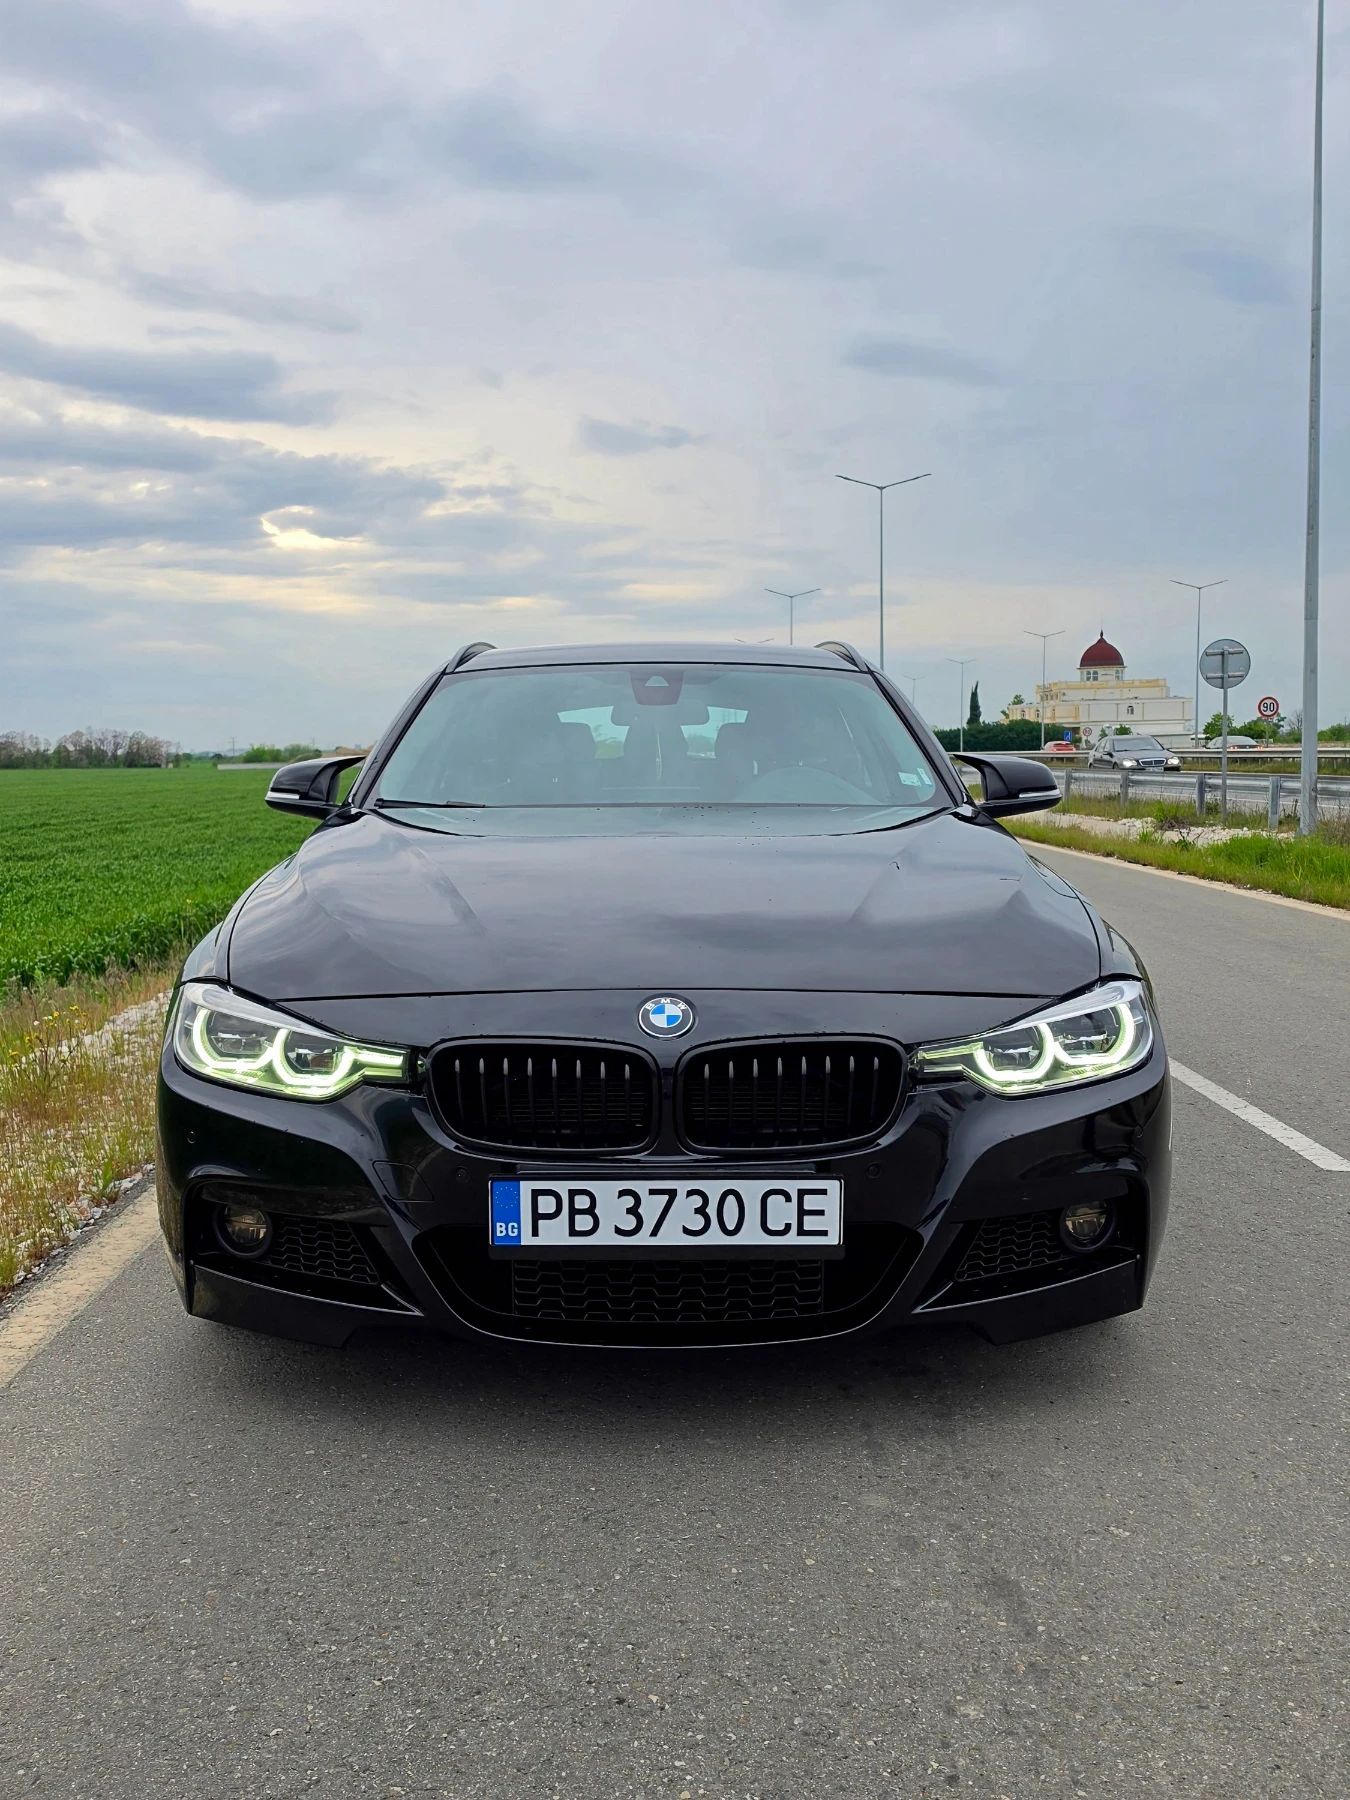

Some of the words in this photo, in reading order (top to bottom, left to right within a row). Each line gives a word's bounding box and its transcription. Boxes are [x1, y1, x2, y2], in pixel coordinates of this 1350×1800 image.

[1262, 702, 1275, 712] 90
[645, 998, 688, 1010] BMW
[530, 1188, 600, 1238] PB
[614, 1188, 746, 1238] 3730
[759, 1188, 829, 1238] CE
[496, 1222, 519, 1237] BG
